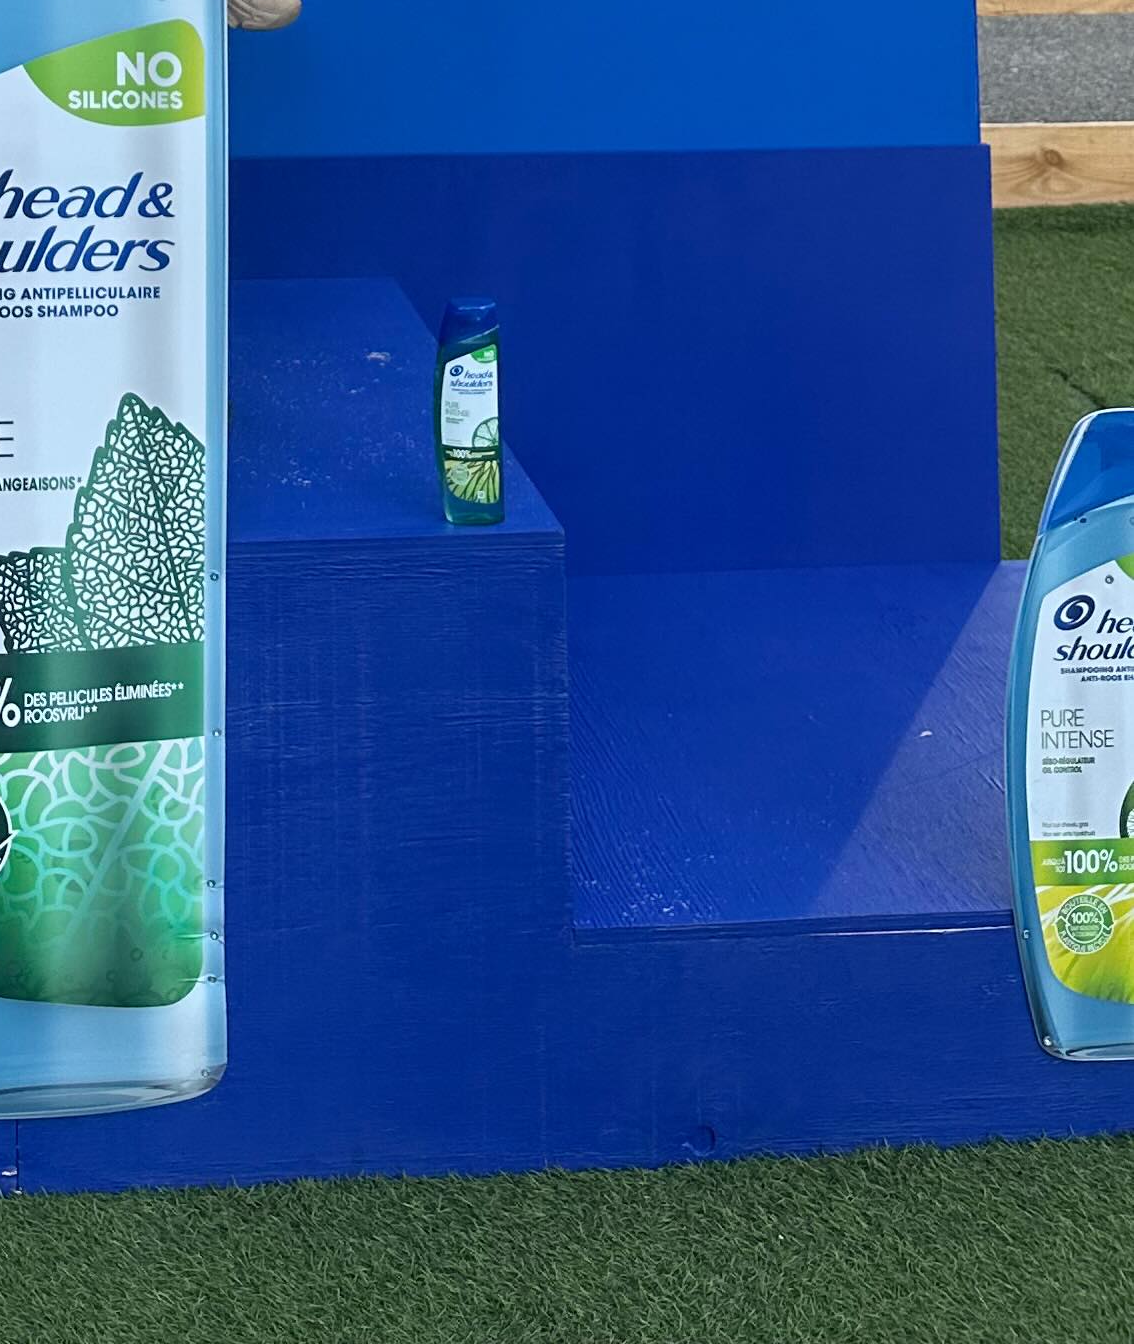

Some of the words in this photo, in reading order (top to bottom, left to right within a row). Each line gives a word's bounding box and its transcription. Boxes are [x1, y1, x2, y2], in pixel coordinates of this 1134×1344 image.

[116, 51, 182, 87] NO
[68, 89, 183, 110] SILICONES
[137, 182, 176, 218] &
[20, 286, 161, 300] ANTIPELLICULAIRE
[37, 304, 119, 318] SHAMPOO
[1096, 609, 1134, 634] he
[1053, 636, 1134, 661] shoul
[24, 692, 48, 708] DES
[49, 688, 113, 707] PELLICULES
[1040, 708, 1085, 728] PURE
[1041, 729, 1115, 749] INTENSE
[1064, 848, 1118, 874] 100%
[1070, 911, 1099, 924] 100%
